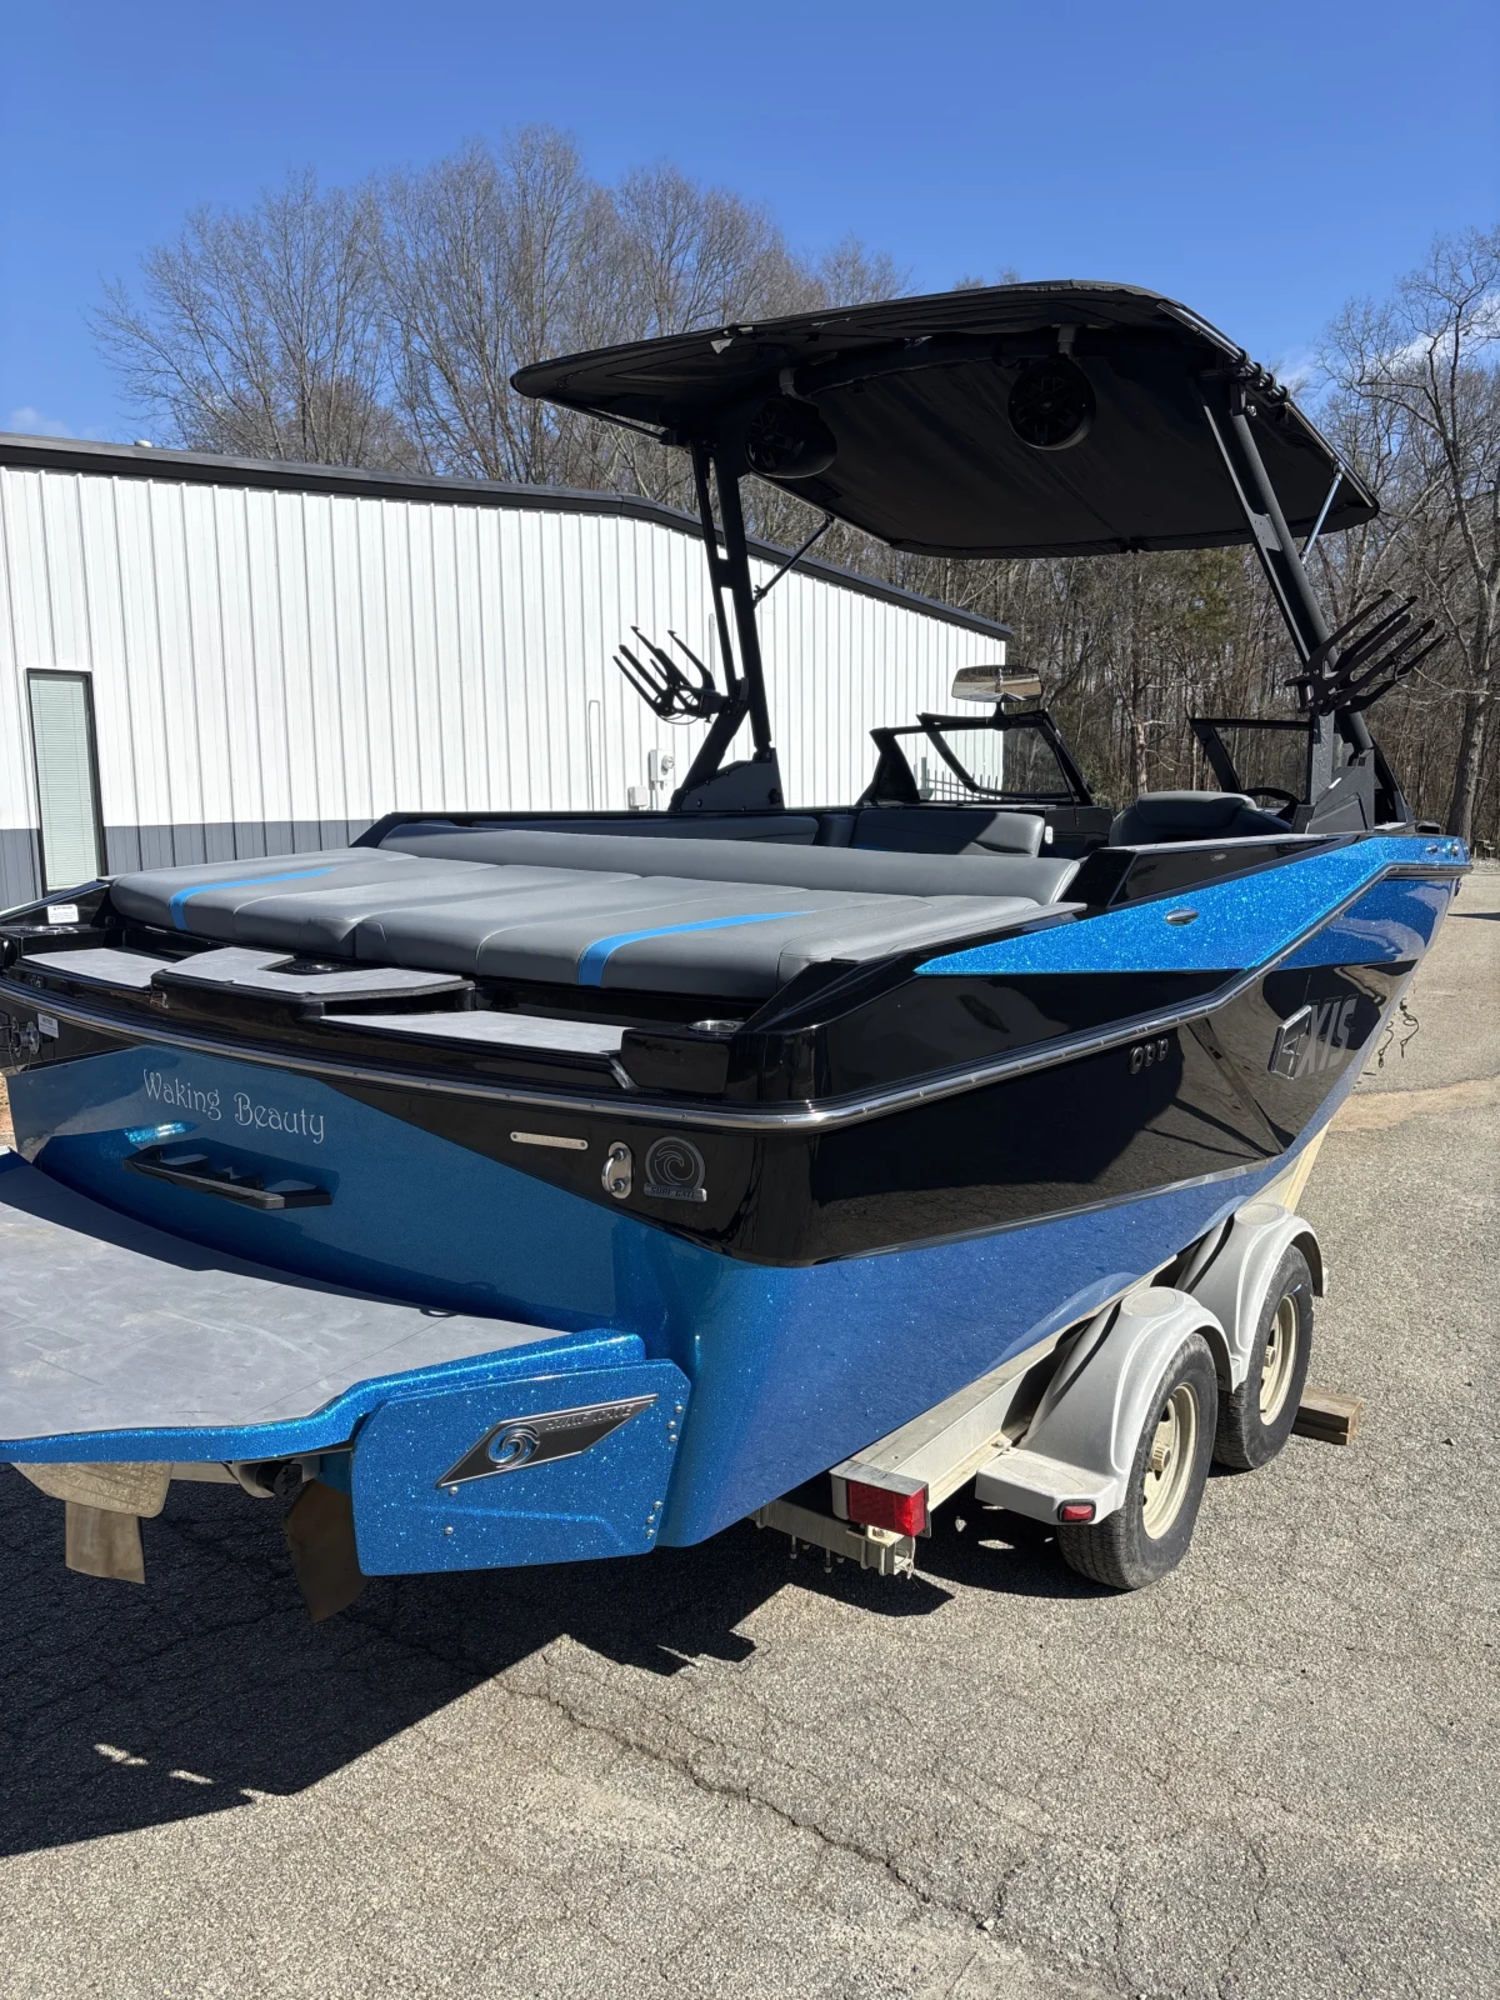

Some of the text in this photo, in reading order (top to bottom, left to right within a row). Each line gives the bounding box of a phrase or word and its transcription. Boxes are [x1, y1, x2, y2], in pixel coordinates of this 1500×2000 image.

[1268, 993, 1358, 1080] AXIS
[144, 1069, 325, 1145] Waking Beauty
